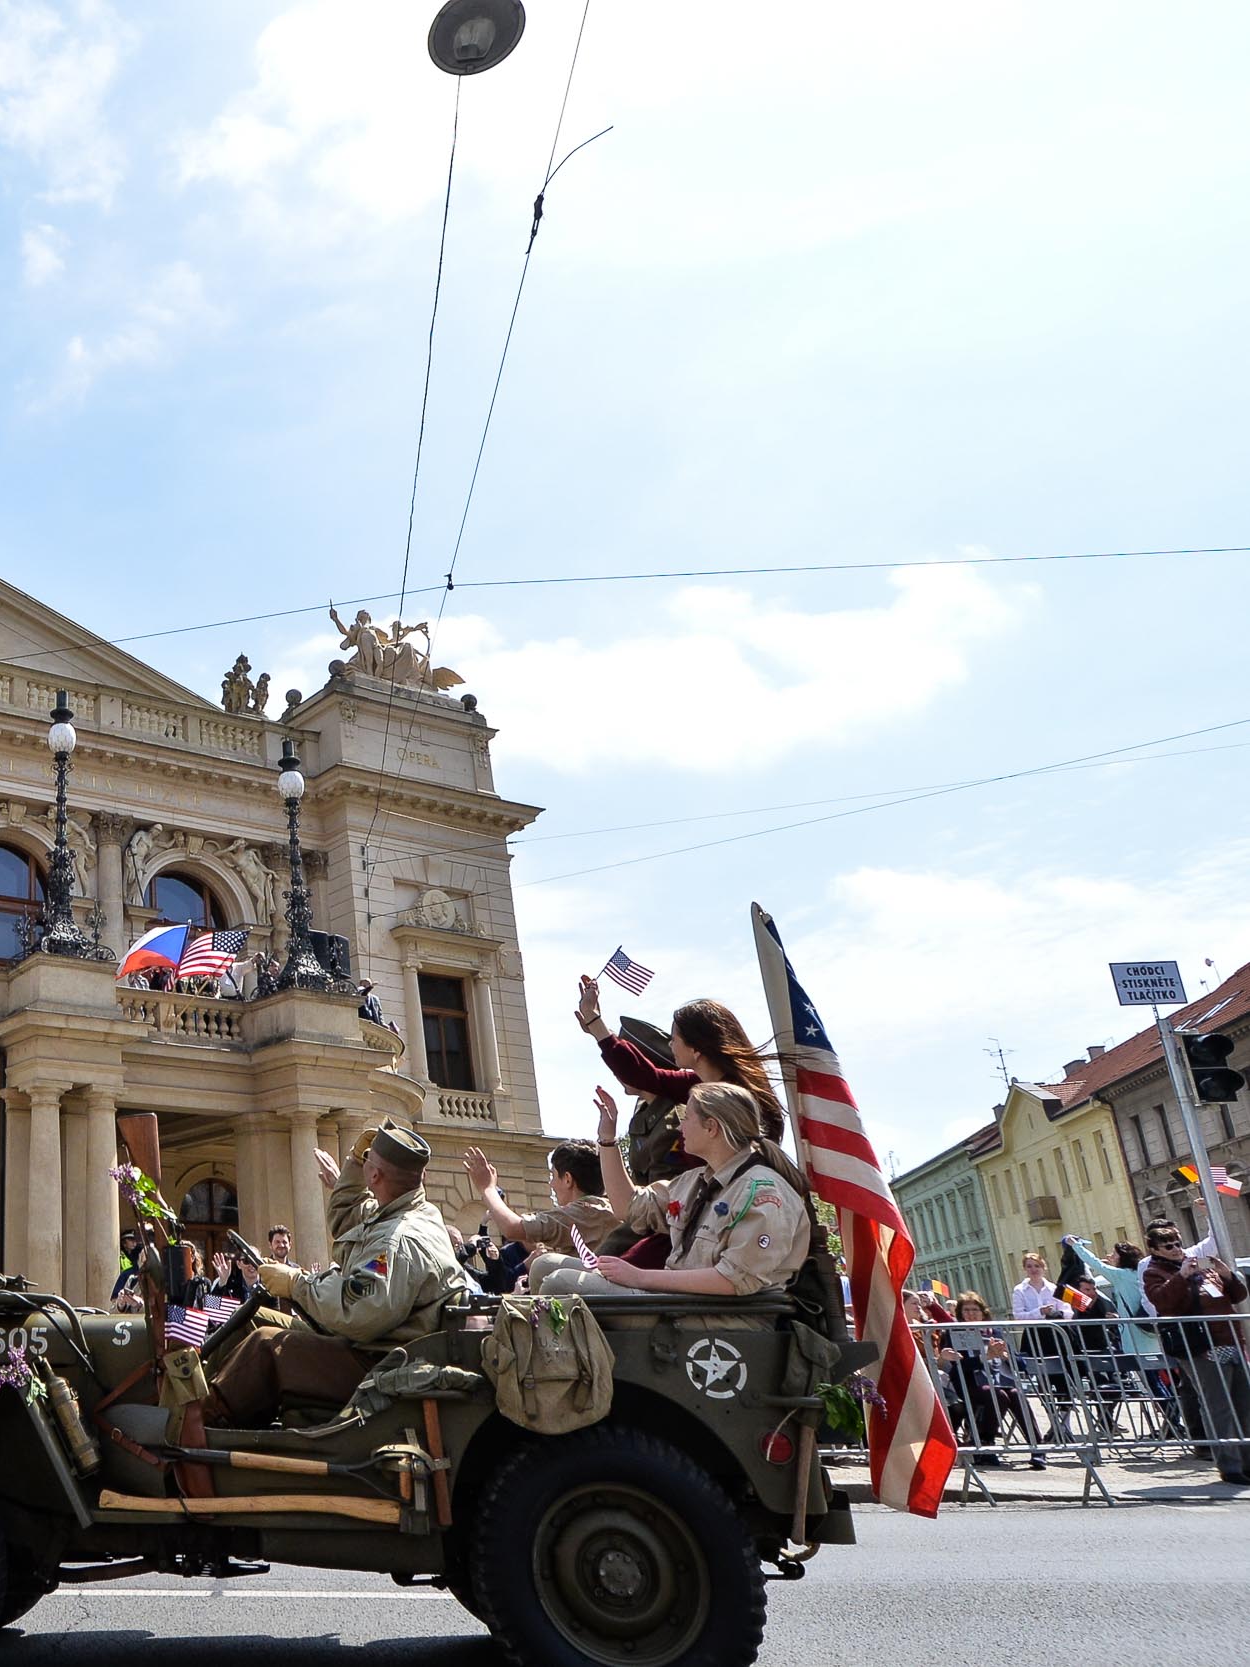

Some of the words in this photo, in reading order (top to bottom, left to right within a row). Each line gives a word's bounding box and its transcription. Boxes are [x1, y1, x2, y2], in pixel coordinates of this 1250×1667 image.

[396, 747, 442, 769] OPERA
[1126, 966, 1165, 976] CHODCI
[1122, 976, 1175, 988] STISKNĚTE
[1127, 988, 1176, 1000] TLAČÍTKO
[112, 1322, 131, 1346] S
